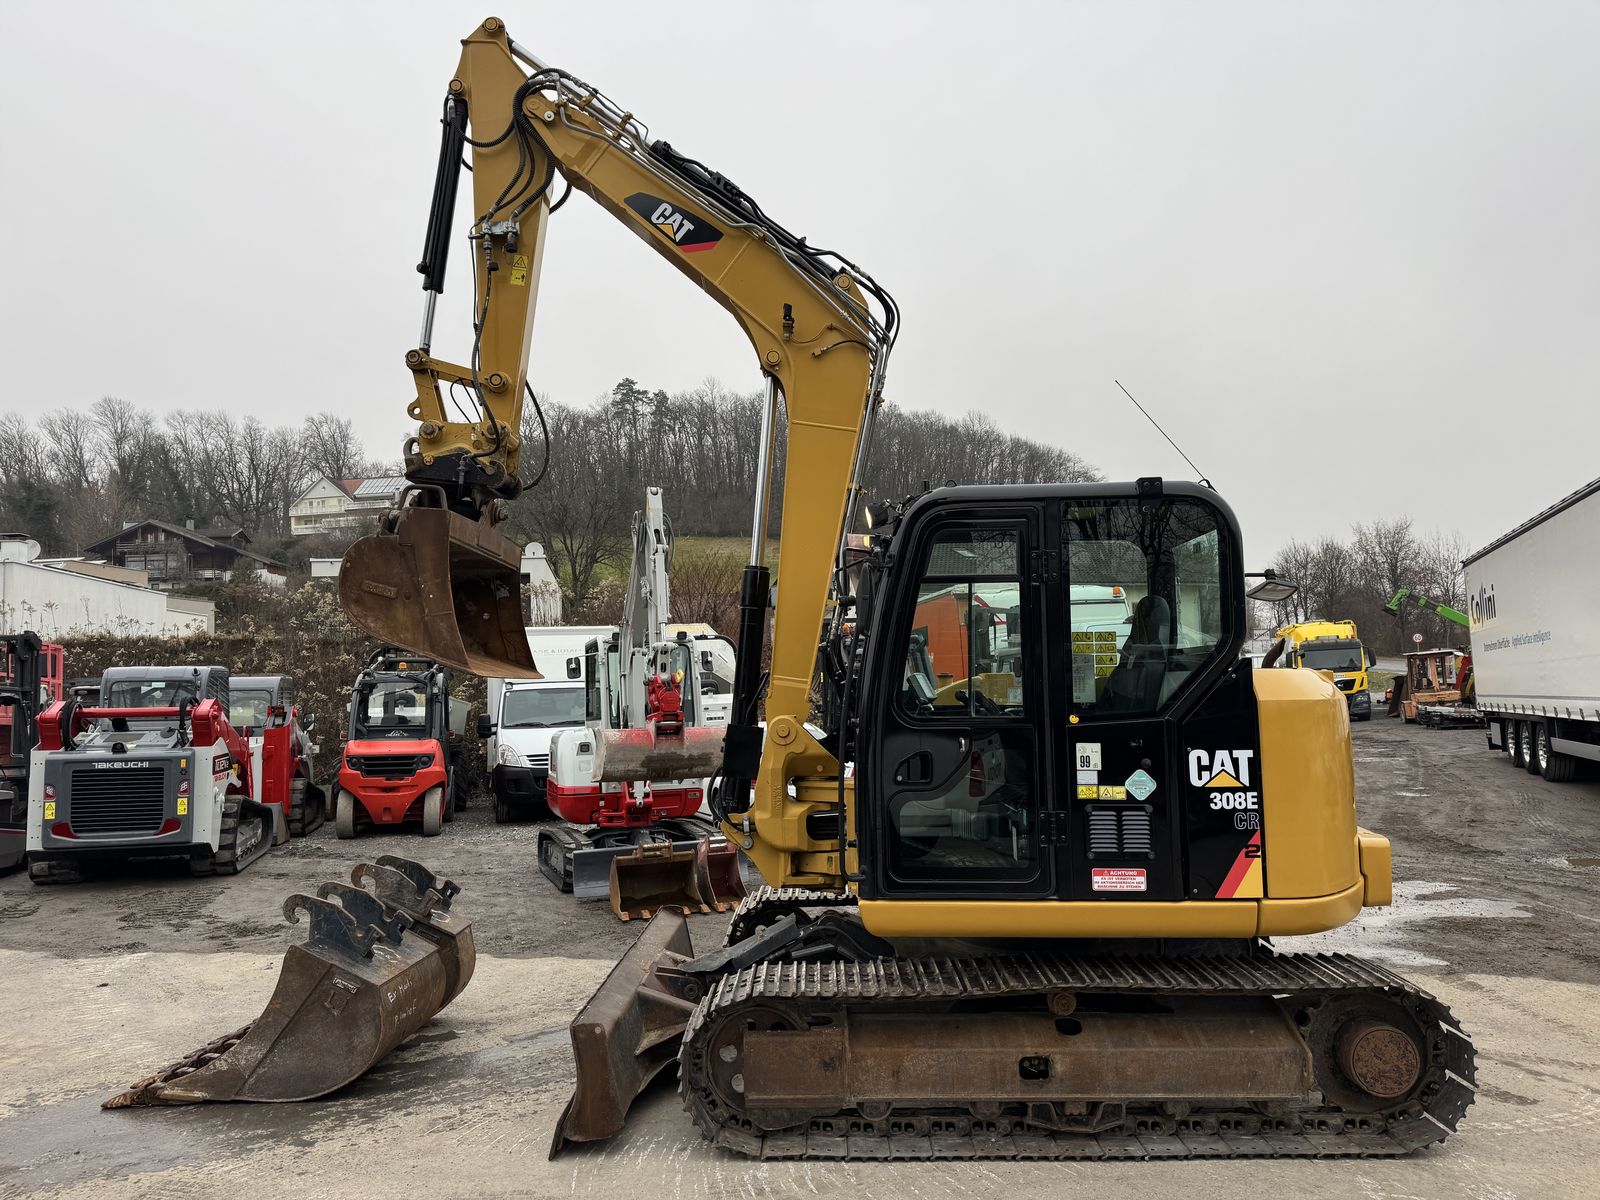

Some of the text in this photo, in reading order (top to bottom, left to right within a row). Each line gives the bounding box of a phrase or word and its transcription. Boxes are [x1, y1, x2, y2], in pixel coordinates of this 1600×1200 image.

[651, 202, 695, 242] CAT
[1470, 582, 1497, 628] Collini
[92, 761, 149, 769] TAKEUCHI
[1080, 755, 1091, 769] 99
[1188, 749, 1254, 788] CAT
[1209, 791, 1259, 810] 308E
[1233, 812, 1260, 830] CR
[1244, 844, 1261, 859] 2
